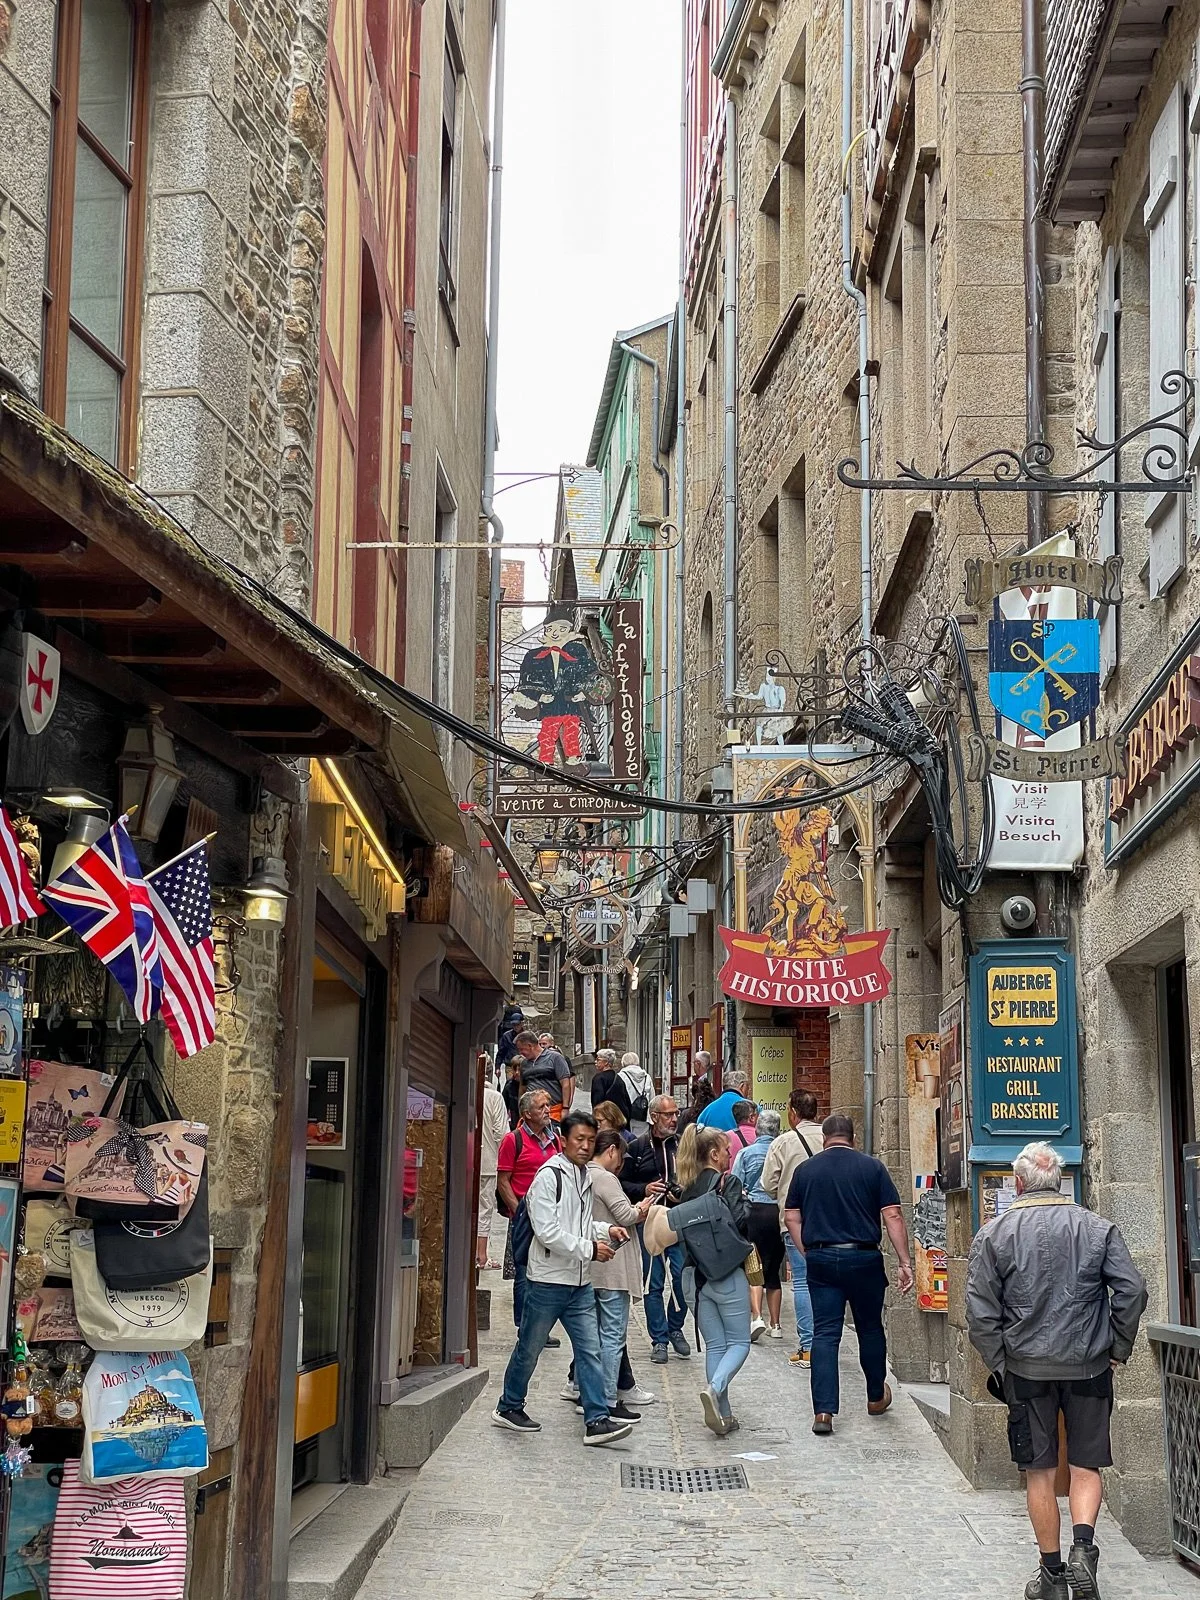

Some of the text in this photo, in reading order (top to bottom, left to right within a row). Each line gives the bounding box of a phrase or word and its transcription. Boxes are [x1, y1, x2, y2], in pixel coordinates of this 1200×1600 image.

[1009, 560, 1077, 587] Hotel
[615, 608, 639, 778] La fringale
[993, 750, 1100, 777] St Pierre
[1012, 783, 1048, 794] Visit
[1013, 797, 1047, 810] 見学
[1006, 815, 1055, 826] Visita
[1000, 830, 1061, 841] Besuch
[766, 957, 847, 980] VISITE
[729, 971, 883, 1004] HISTORIQUE
[992, 974, 1052, 991] AUBERGE
[1009, 1001, 1056, 1018] PIERRE
[673, 1032, 688, 1043] Bar
[760, 1046, 785, 1062] Crêpes
[987, 1056, 1062, 1073] RESTAURANT
[757, 1071, 788, 1083] Galettes
[1006, 1080, 1041, 1096] GRILL
[760, 1099, 787, 1112] Gaufres
[991, 1102, 1059, 1119] BRASSERIE
[142, 1304, 162, 1312] 1979
[101, 1372, 128, 1389] MONT
[74, 1513, 89, 1528] LE
[147, 1500, 176, 1529] MICHEL
[88, 1540, 167, 1558] Normandie
